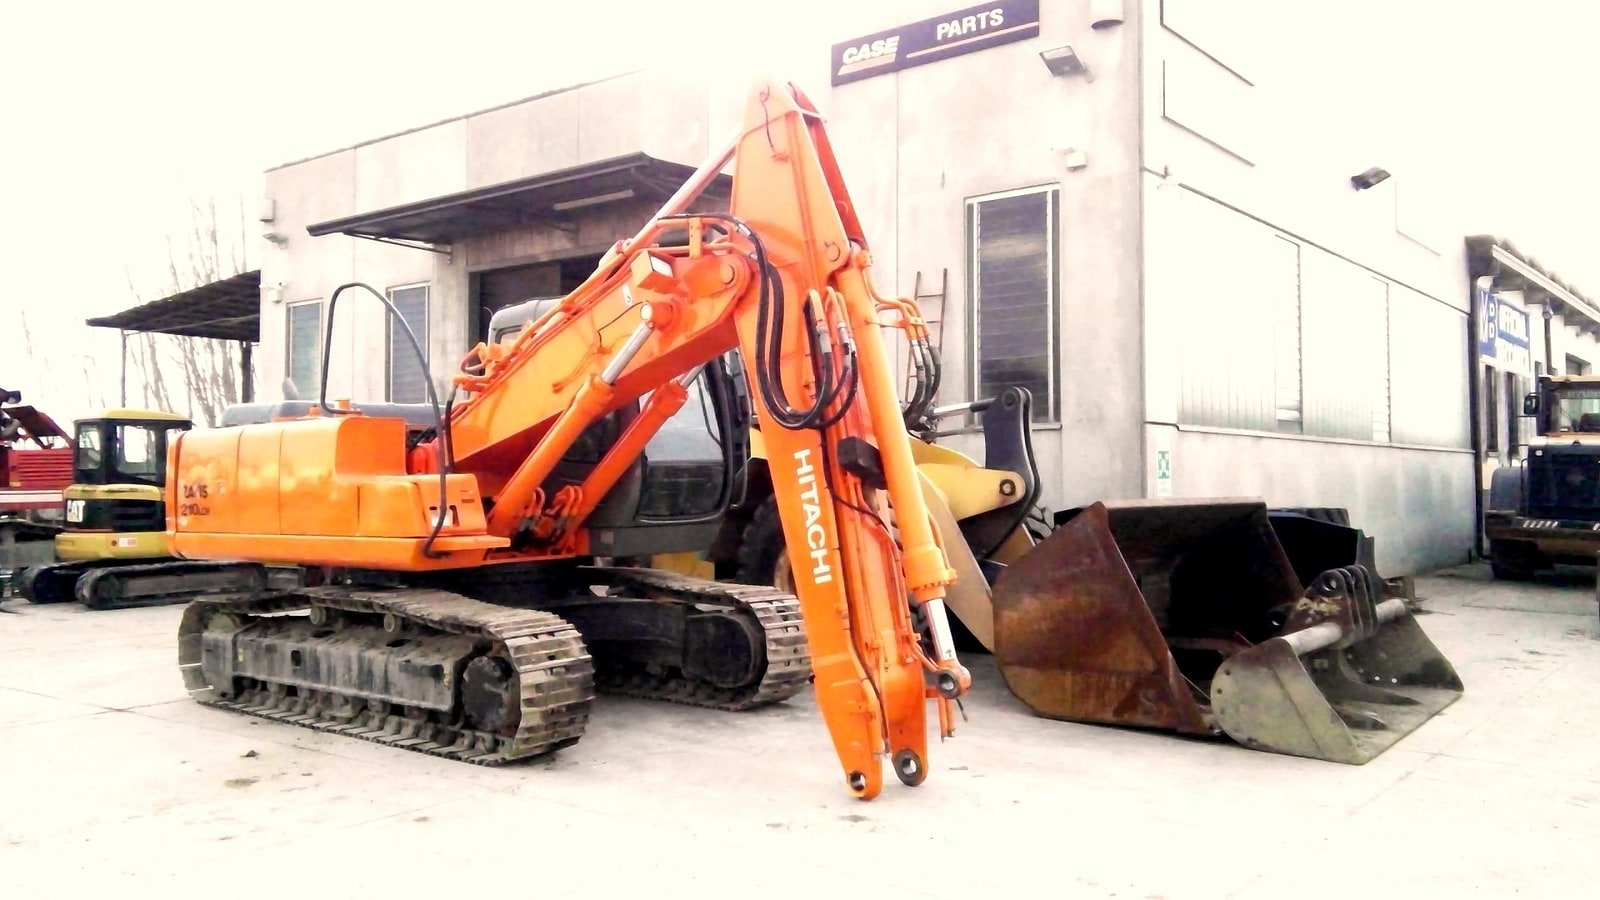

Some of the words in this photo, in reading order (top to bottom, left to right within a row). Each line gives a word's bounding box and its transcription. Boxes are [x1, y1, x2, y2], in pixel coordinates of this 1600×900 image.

[843, 35, 899, 64] CASE
[936, 8, 1004, 41] PARTS
[67, 499, 86, 522] CAT
[794, 449, 832, 584] HITACHI
